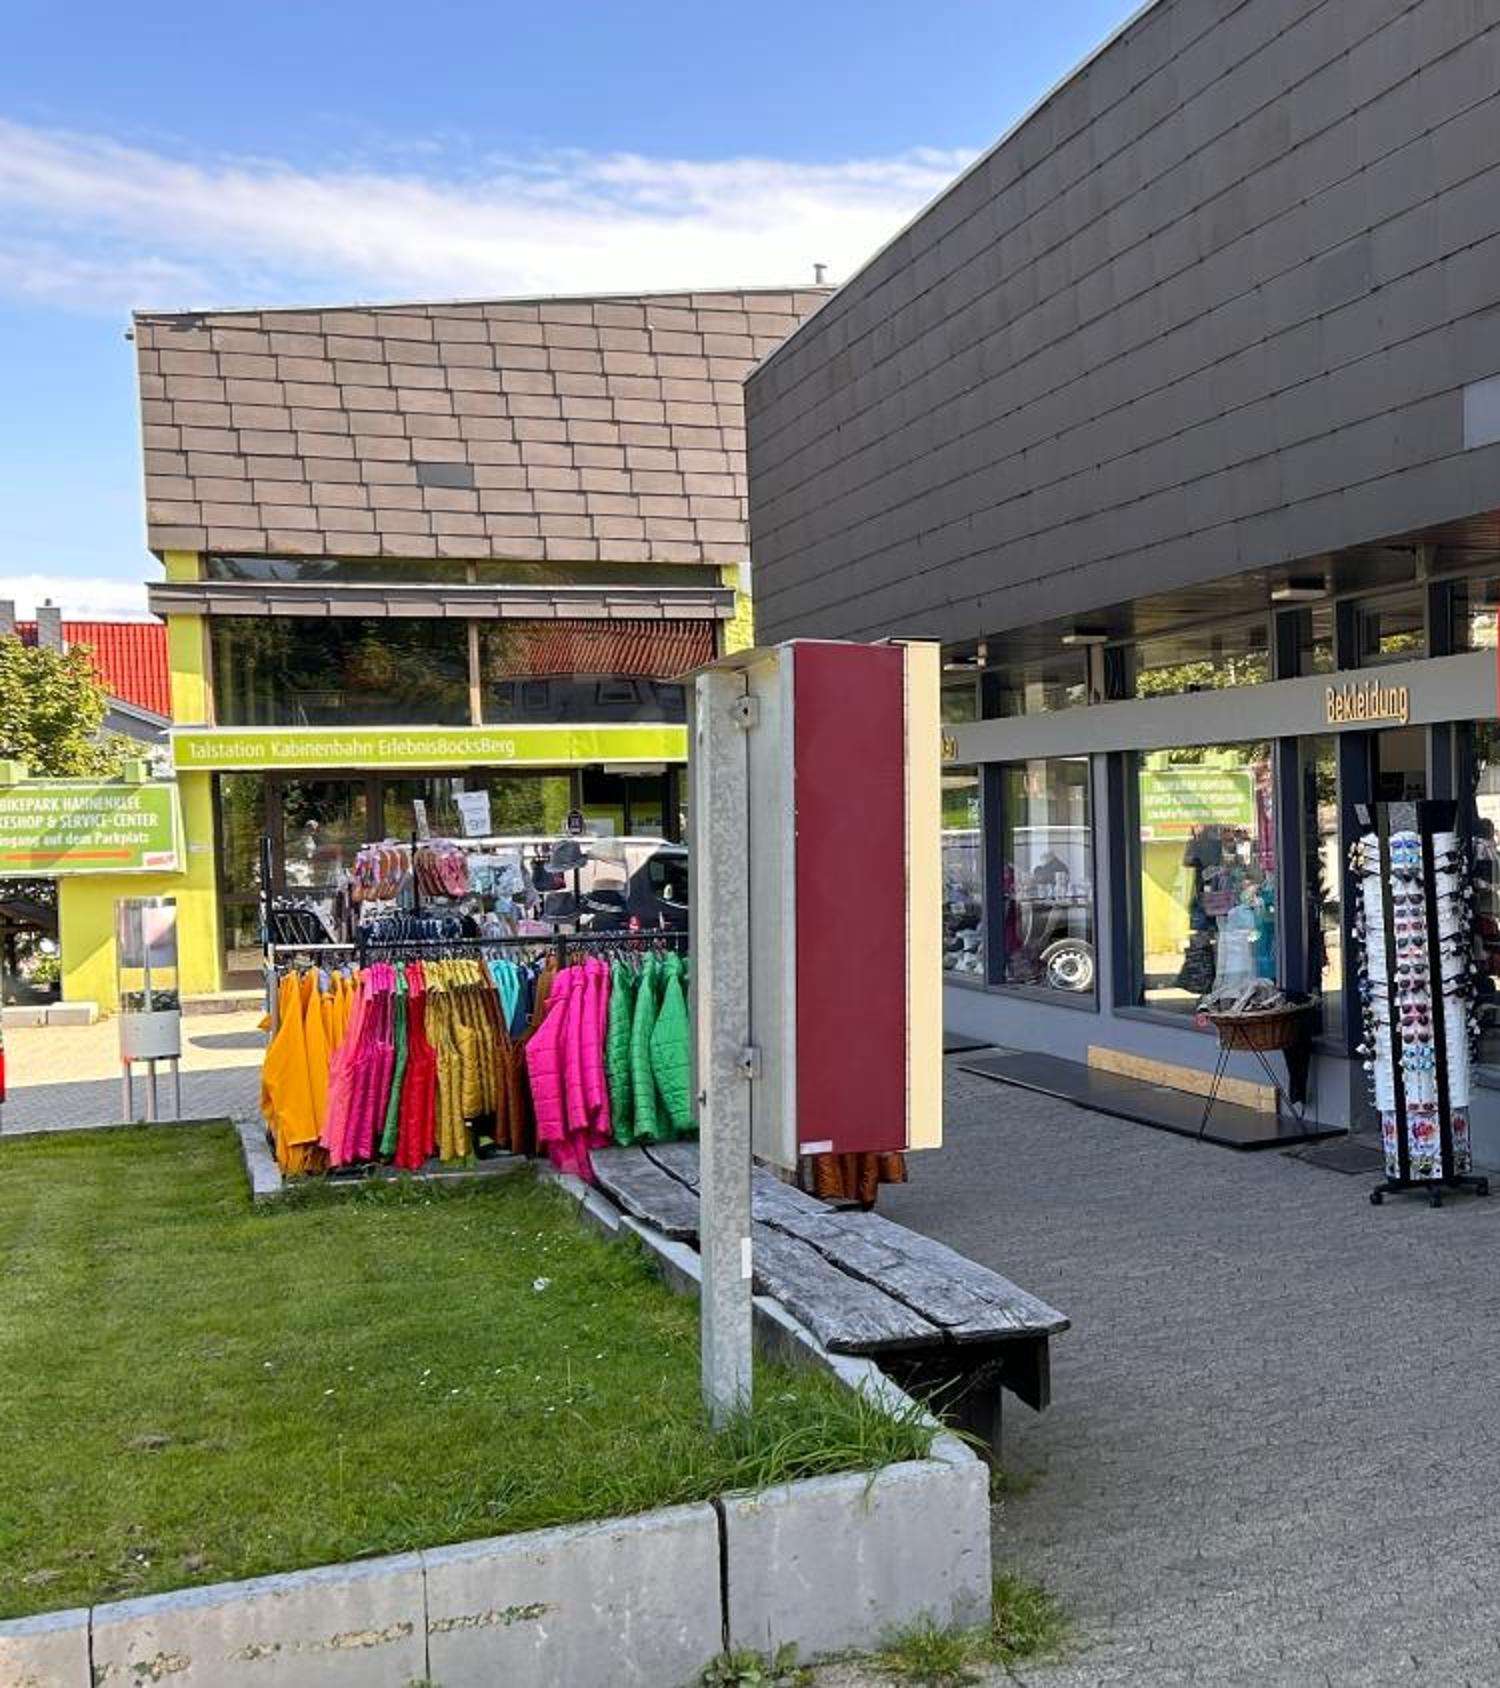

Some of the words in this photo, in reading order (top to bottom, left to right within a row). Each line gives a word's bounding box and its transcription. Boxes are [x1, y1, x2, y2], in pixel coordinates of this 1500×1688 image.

[1326, 679, 1408, 725] Bekleidung
[191, 741, 264, 760] Talstation
[271, 739, 373, 758] Kabinenbahn
[377, 737, 515, 757] ErlebnisBocksBerg
[60, 812, 159, 829] SERVICE-CENTER
